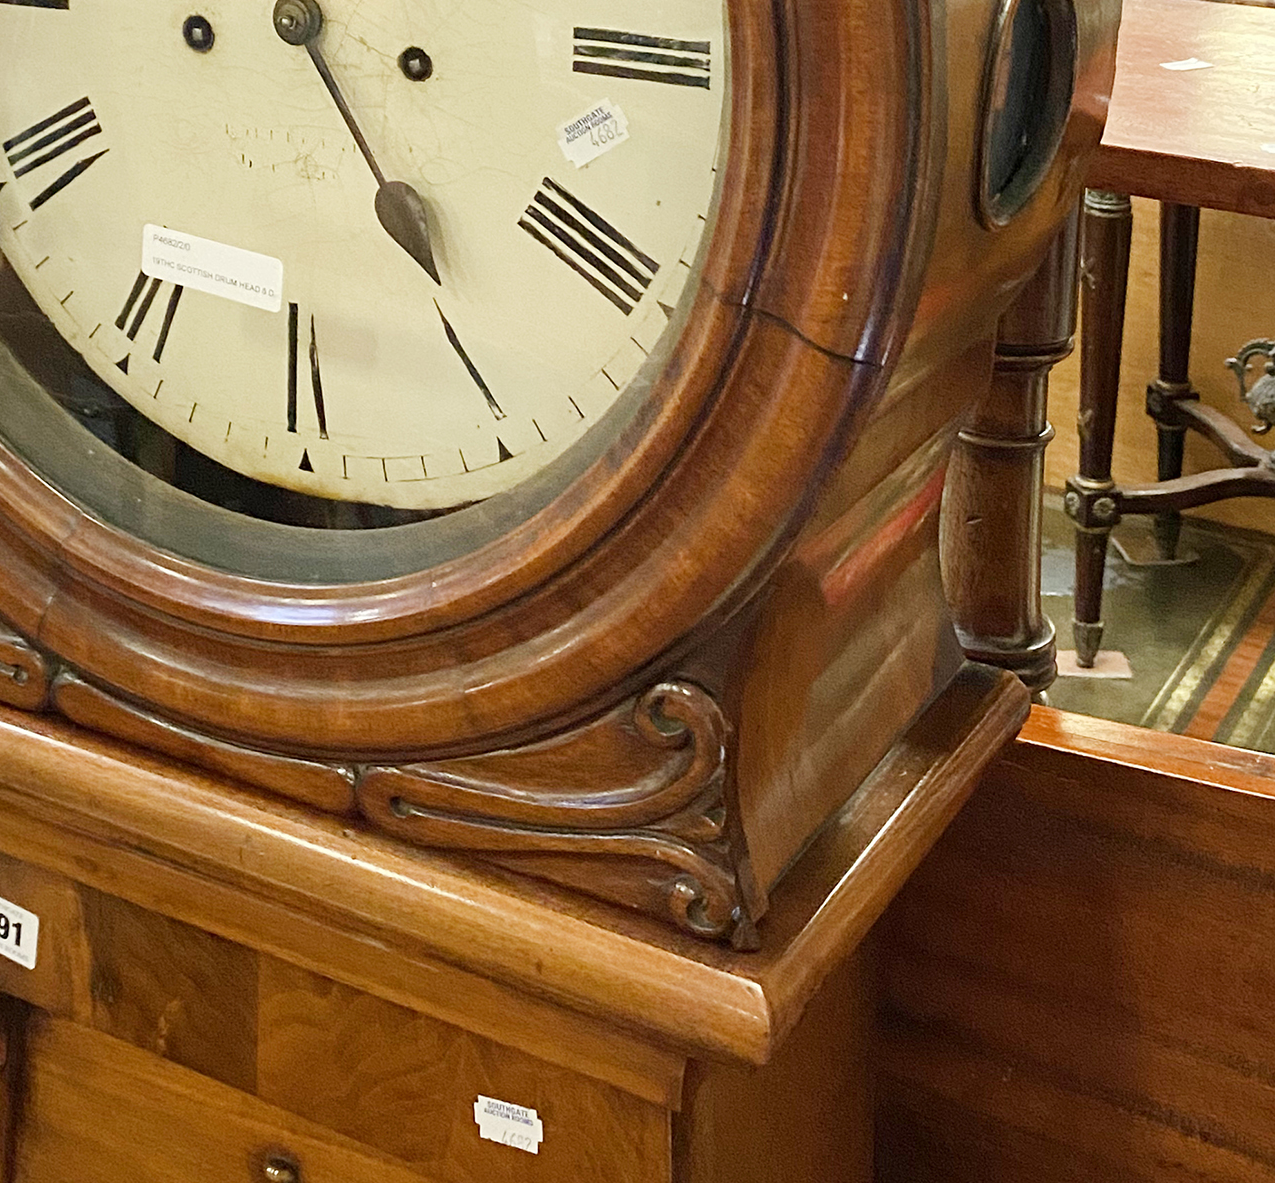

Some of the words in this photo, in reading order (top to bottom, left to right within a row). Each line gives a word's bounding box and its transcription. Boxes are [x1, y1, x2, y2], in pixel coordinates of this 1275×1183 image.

[564, 106, 605, 135] SOUTHGATE
[566, 124, 592, 145] AUCTION
[589, 119, 625, 147] 4682
[176, 262, 214, 280] SCOTTISH
[214, 273, 238, 287] DRUM
[238, 280, 261, 294] HEAD
[484, 1107, 511, 1119] AUCTION
[486, 1100, 529, 1118] SOUTHGATE
